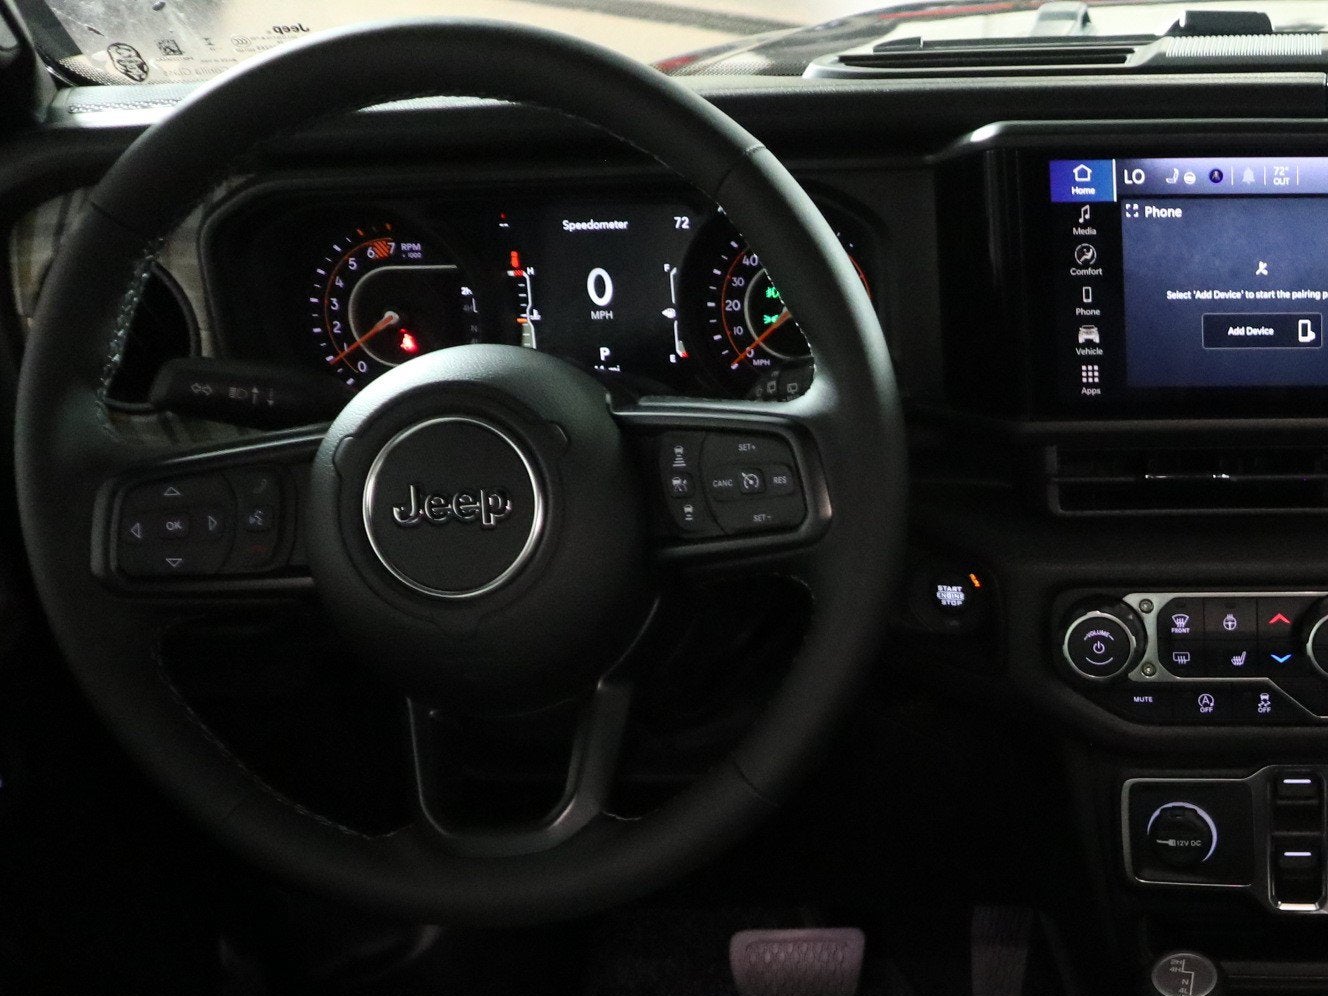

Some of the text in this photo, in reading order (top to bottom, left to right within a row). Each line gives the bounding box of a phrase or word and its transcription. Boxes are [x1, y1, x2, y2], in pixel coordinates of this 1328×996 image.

[1124, 169, 1145, 184] LO
[1273, 177, 1290, 186] OUT
[1071, 186, 1095, 196] Home
[1144, 206, 1182, 218] Phone
[562, 219, 628, 232] Speedometer
[674, 216, 690, 229] 72
[1072, 226, 1097, 236] Media
[388, 242, 396, 254] 7
[401, 243, 421, 251] RPM
[367, 247, 375, 259] 6
[348, 258, 358, 271] 5
[742, 255, 760, 266] 40
[1070, 267, 1103, 276] Comfort
[334, 276, 344, 288] 4
[587, 267, 613, 306] 0
[731, 277, 745, 287] 30
[1166, 290, 1192, 300] Select
[1193, 290, 1212, 300] 'Add
[1245, 290, 1255, 300] to
[1255, 290, 1275, 300] start
[1276, 290, 1291, 300] the
[1291, 290, 1321, 300] pairing
[330, 299, 339, 311] 3
[725, 300, 742, 311] 20
[590, 310, 614, 320] MPH
[1075, 307, 1100, 316] Phone
[332, 321, 341, 334] 2
[733, 325, 744, 335] 10
[1228, 327, 1274, 336] Add Device
[600, 347, 610, 361] P
[1075, 346, 1103, 356] Vehicle
[357, 361, 367, 373] 0
[752, 359, 771, 367] MPH
[1081, 386, 1101, 396] Apps
[712, 479, 733, 488] CANC
[773, 476, 787, 485] RES
[392, 484, 512, 528] Jeep
[937, 585, 963, 593] START
[938, 592, 965, 600] ENGINE
[1086, 630, 1111, 639] VOLUME
[1176, 839, 1202, 847] 12V DC
